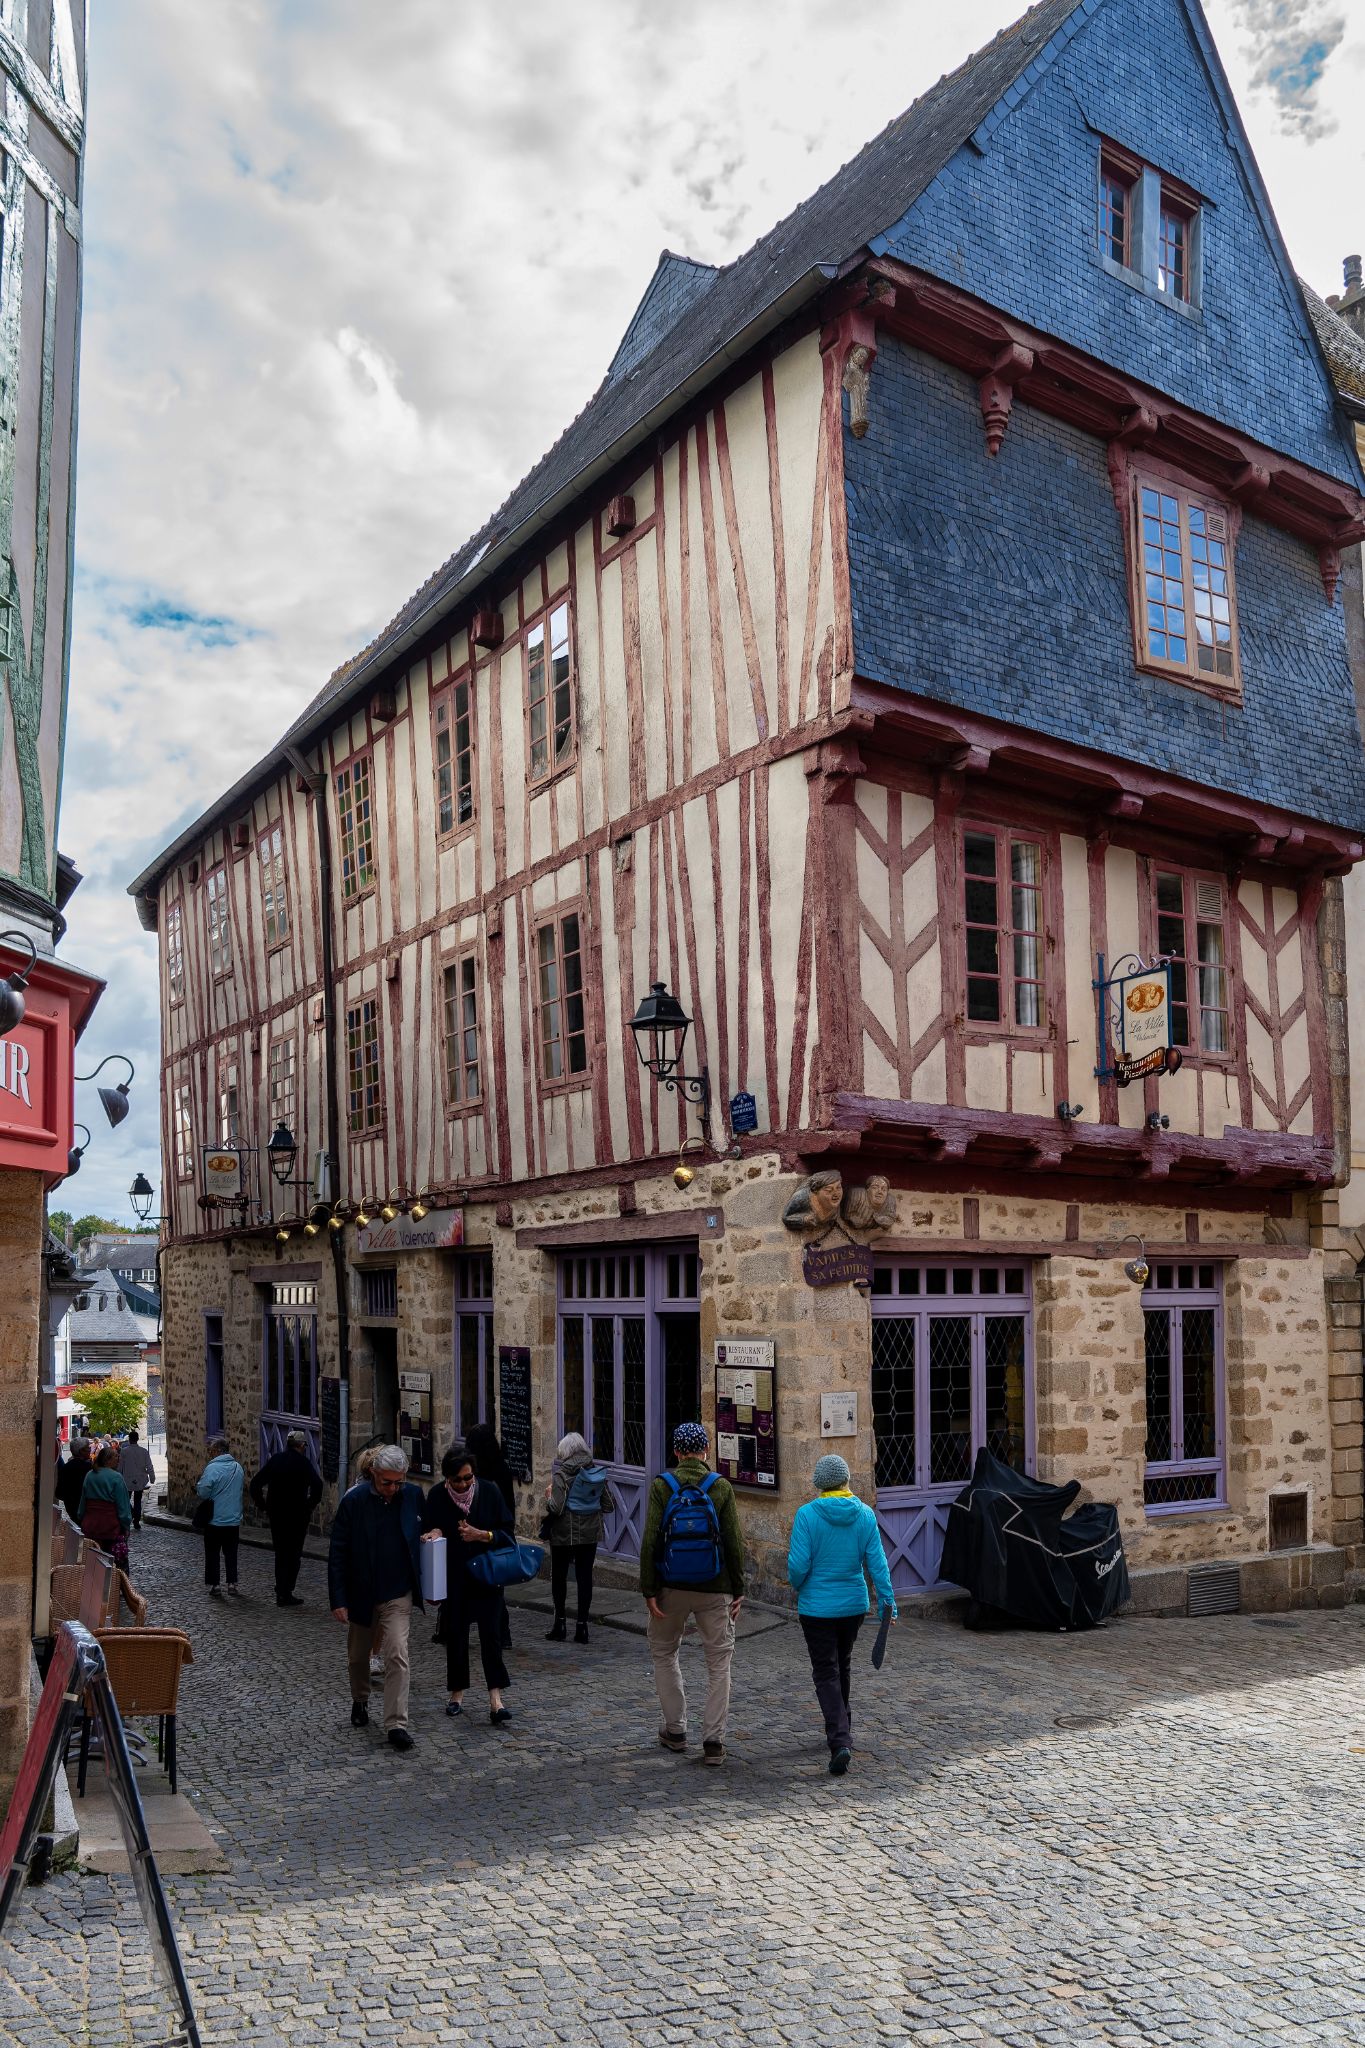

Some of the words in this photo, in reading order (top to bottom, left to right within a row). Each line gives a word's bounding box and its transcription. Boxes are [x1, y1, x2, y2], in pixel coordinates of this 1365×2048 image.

[1128, 1021, 1142, 1033] La
[1145, 1014, 1165, 1030] Villa
[1118, 1049, 1161, 1072] Restaurant
[368, 1224, 397, 1249] Villa
[400, 1229, 436, 1247] Valencia
[829, 1263, 870, 1279] FEMME
[728, 1345, 765, 1355] RESTAURANT
